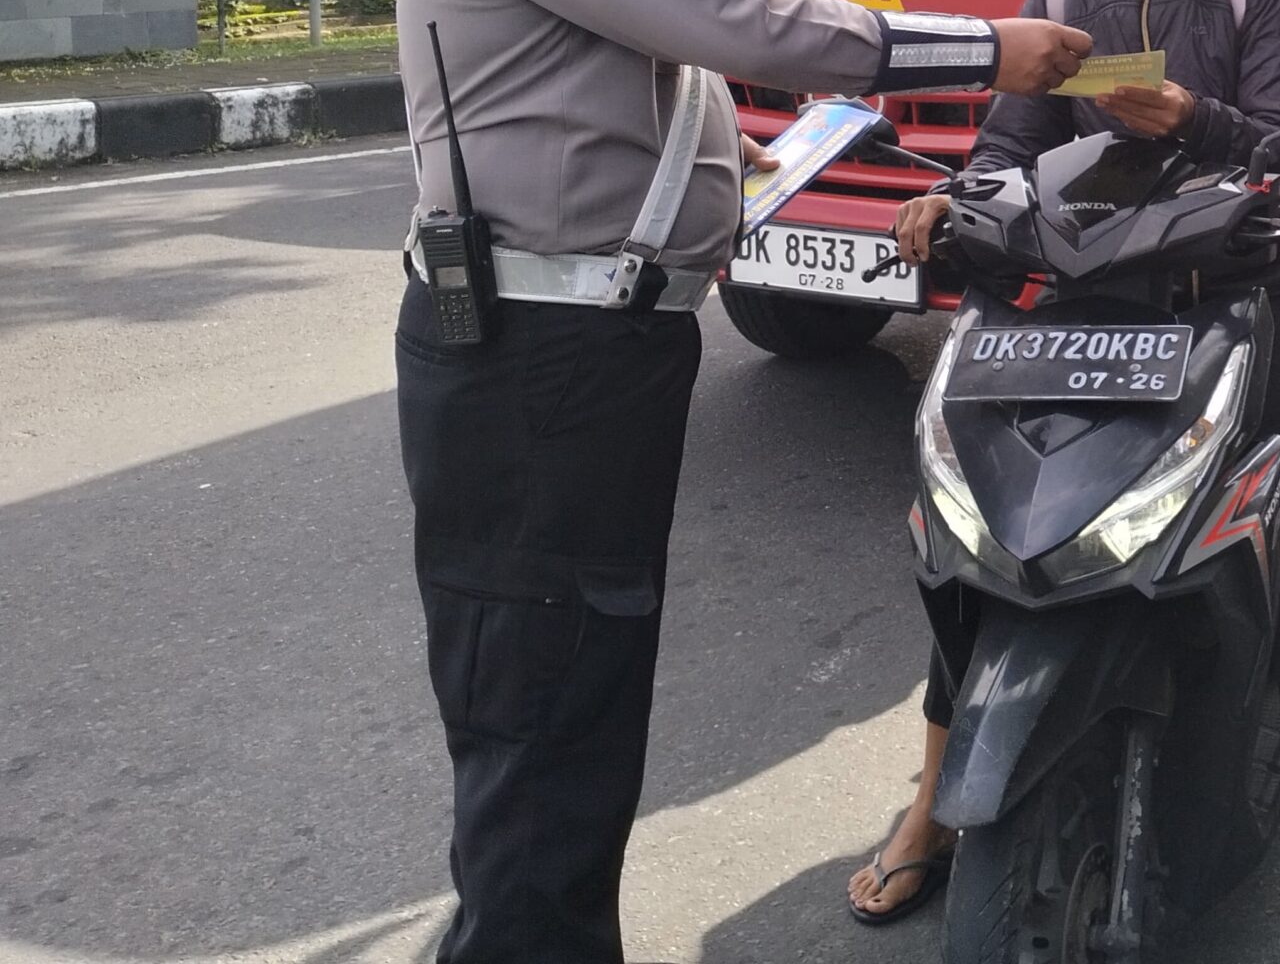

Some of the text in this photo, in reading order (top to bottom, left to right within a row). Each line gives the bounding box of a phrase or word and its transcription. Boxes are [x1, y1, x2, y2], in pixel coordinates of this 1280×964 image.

[1057, 202, 1117, 212] HONDA
[736, 229, 771, 264] DK
[785, 233, 855, 273] 8533
[973, 331, 1179, 361] DK3720KBC
